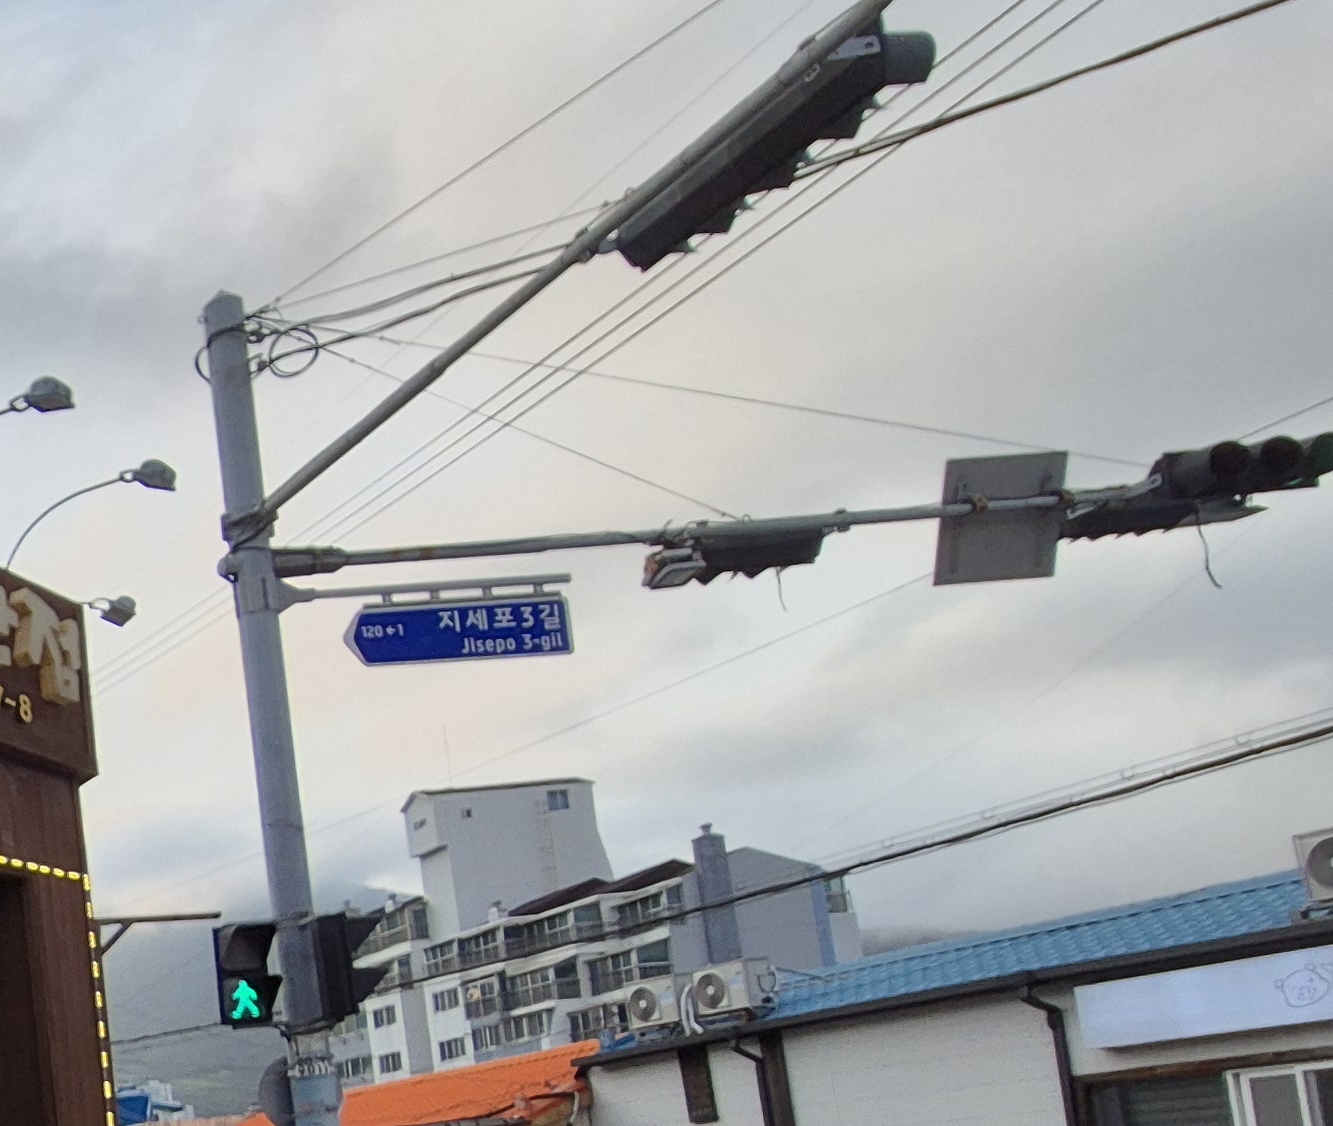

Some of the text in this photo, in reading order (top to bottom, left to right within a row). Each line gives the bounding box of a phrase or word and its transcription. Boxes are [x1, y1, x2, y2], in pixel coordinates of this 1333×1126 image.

[438, 603, 562, 633] 지세포3길
[462, 632, 563, 654] Jisepo 3-gil
